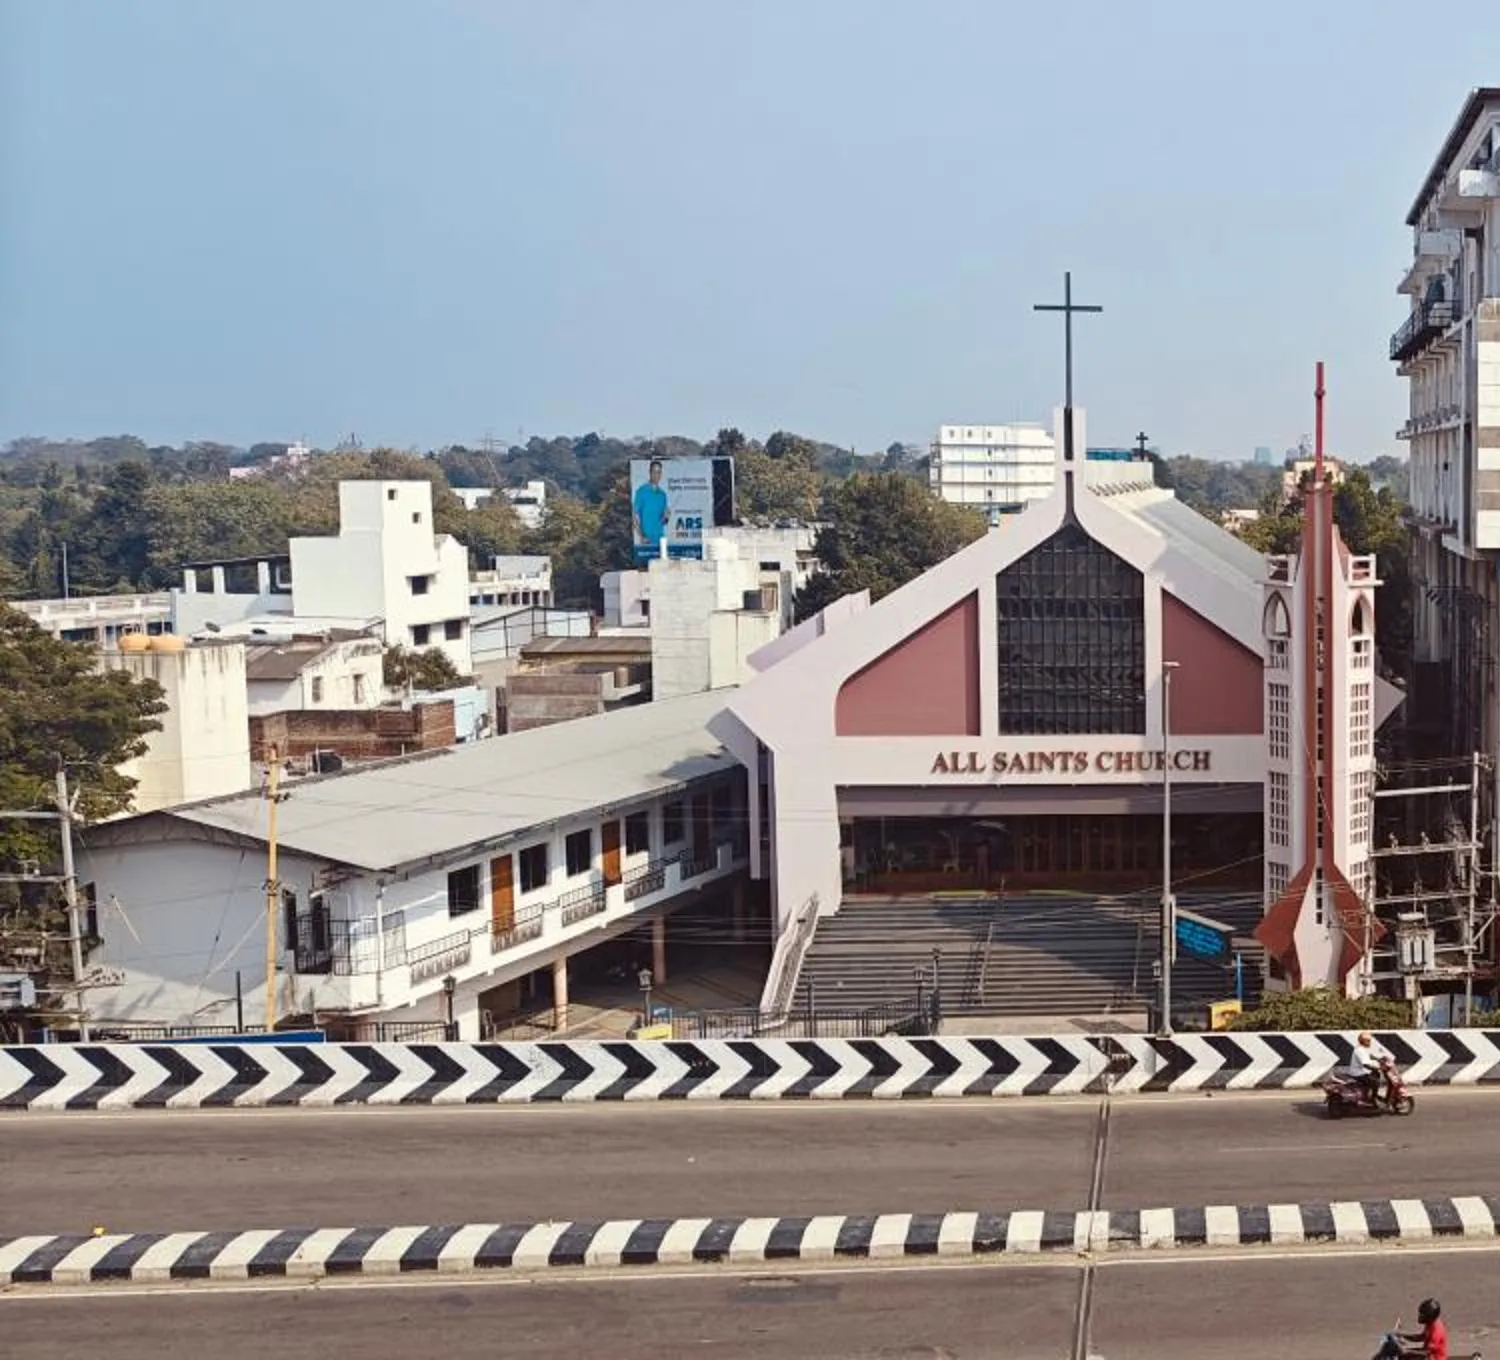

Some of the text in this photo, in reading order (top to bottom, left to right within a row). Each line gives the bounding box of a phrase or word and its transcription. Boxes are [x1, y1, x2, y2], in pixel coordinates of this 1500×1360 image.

[931, 750, 1211, 773] ALL SAINTS CHURCH
